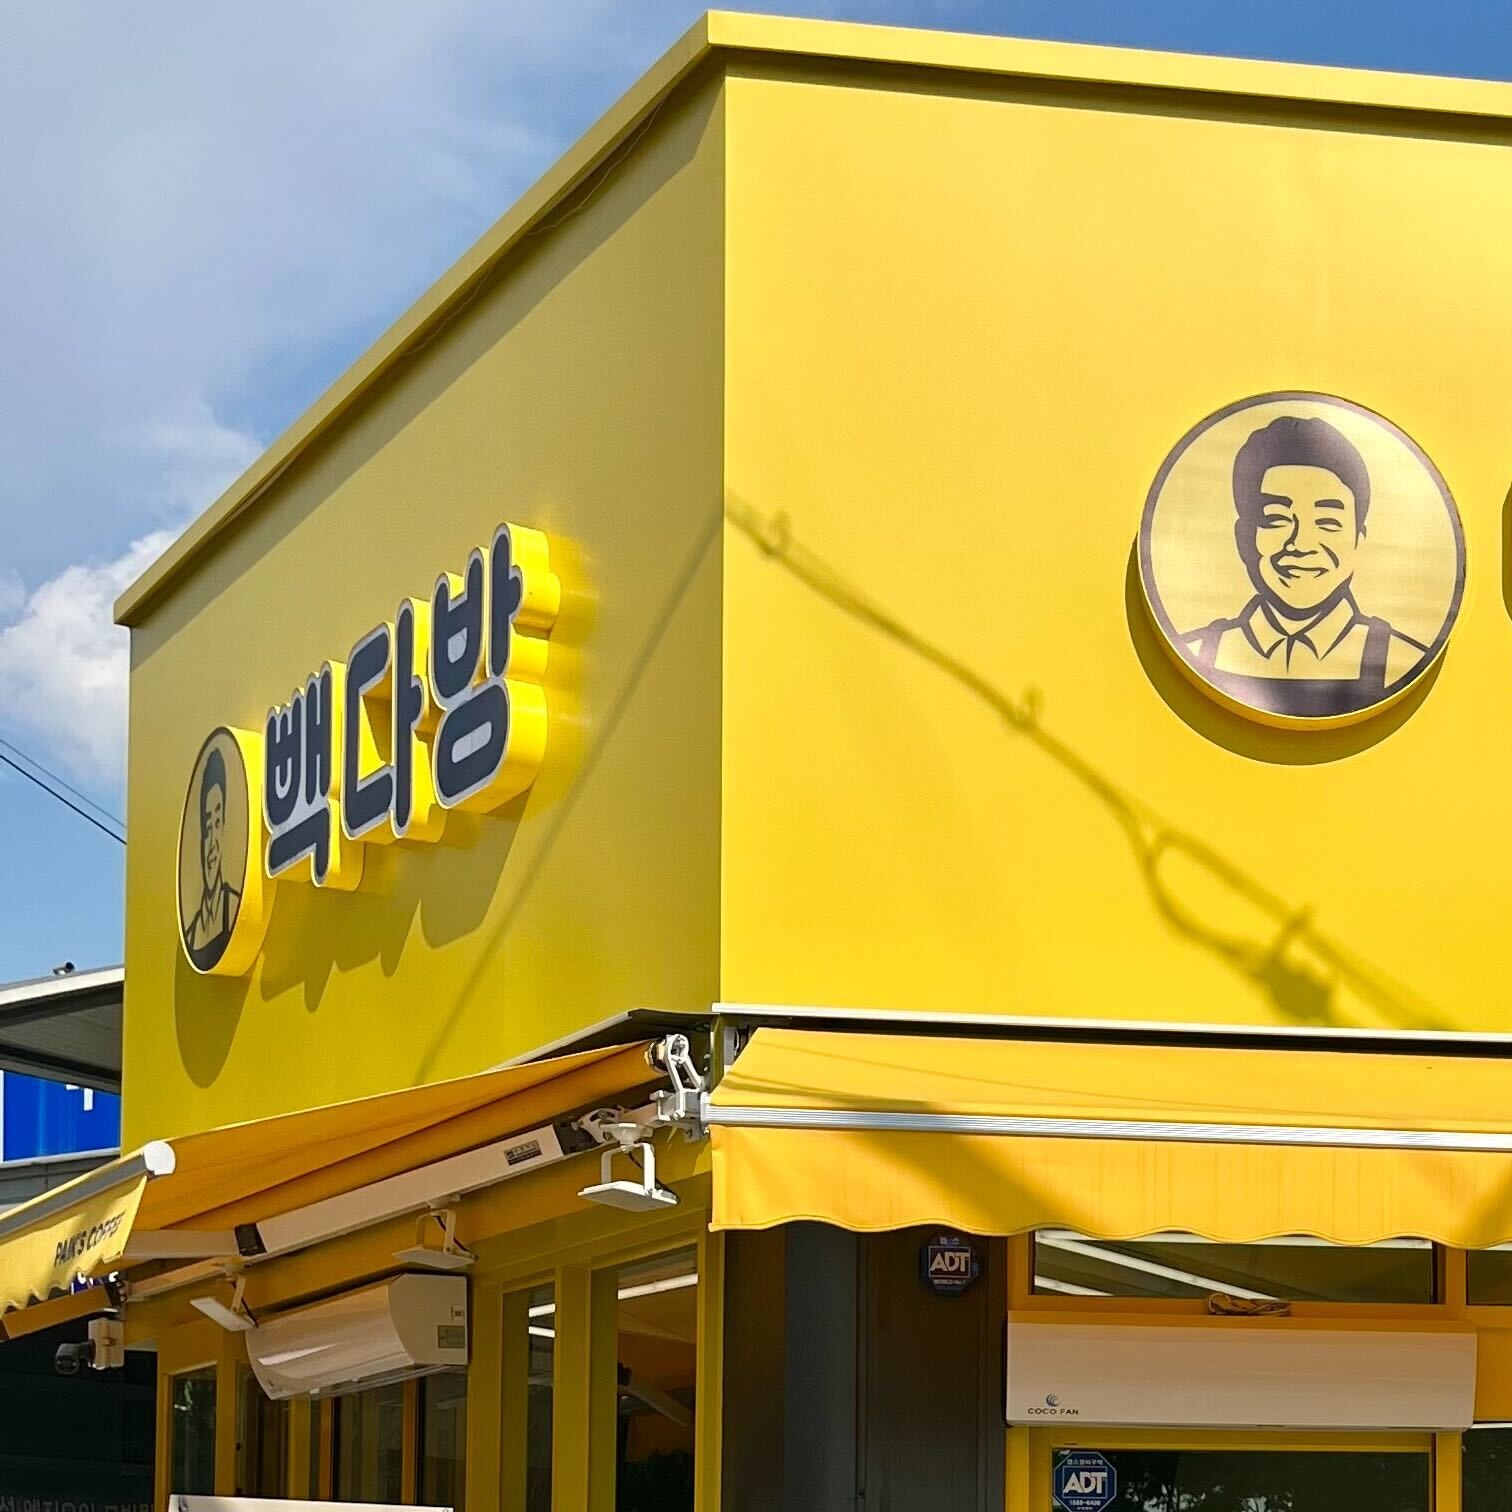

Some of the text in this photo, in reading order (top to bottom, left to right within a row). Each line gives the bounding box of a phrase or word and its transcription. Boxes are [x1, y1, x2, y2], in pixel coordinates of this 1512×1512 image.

[262, 522, 525, 888] 빽다방
[930, 1251, 970, 1272] ADT
[1027, 1407, 1079, 1416] COCO FAN
[1062, 1471, 1108, 1494] ADT
